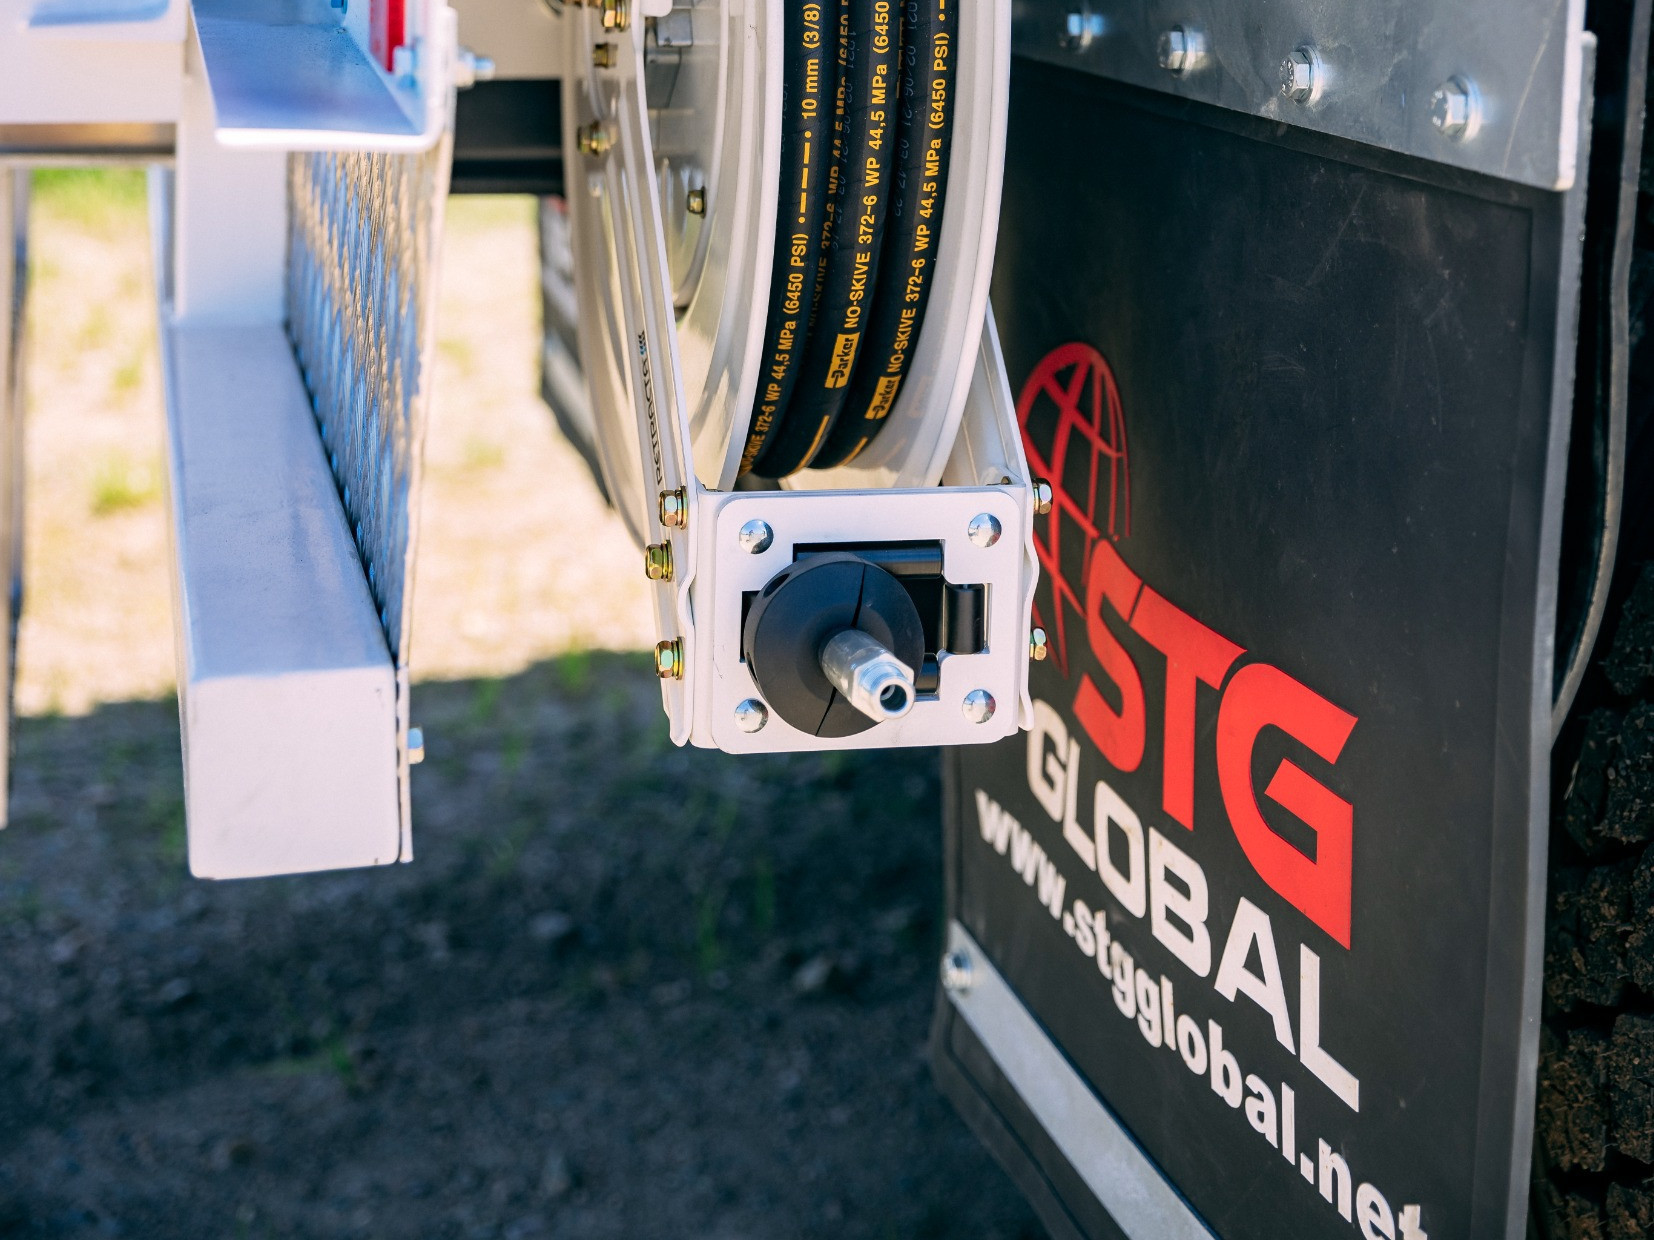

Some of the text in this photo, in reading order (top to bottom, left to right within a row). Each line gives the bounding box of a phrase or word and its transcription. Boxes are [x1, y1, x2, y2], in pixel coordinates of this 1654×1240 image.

[802, 3, 820, 49] (3/8)
[872, 1, 890, 54] (6450
[933, 32, 949, 71] PSI)
[805, 58, 819, 93] mm
[871, 64, 888, 105] MPa
[801, 98, 817, 120] 10
[928, 78, 947, 129] (6450
[869, 110, 886, 150] 44,5
[865, 157, 880, 187] WP
[925, 138, 942, 177] MPa
[858, 195, 878, 244] 372-6
[919, 181, 938, 219] 44,5
[790, 233, 809, 267] PSI)
[914, 224, 931, 252] WP
[782, 273, 804, 315] (6450
[844, 251, 871, 328] NO-SKIVE
[905, 258, 926, 302] 372-6
[778, 321, 797, 350] MPa
[887, 308, 916, 373] NO-SKIVE
[771, 353, 790, 380] 44,5
[830, 336, 856, 387] Parker
[764, 383, 781, 401] WP
[871, 379, 900, 418] Parker
[754, 405, 776, 432] 372-6
[1073, 536, 1359, 951] STG
[1027, 697, 1360, 1113] GLOBAL
